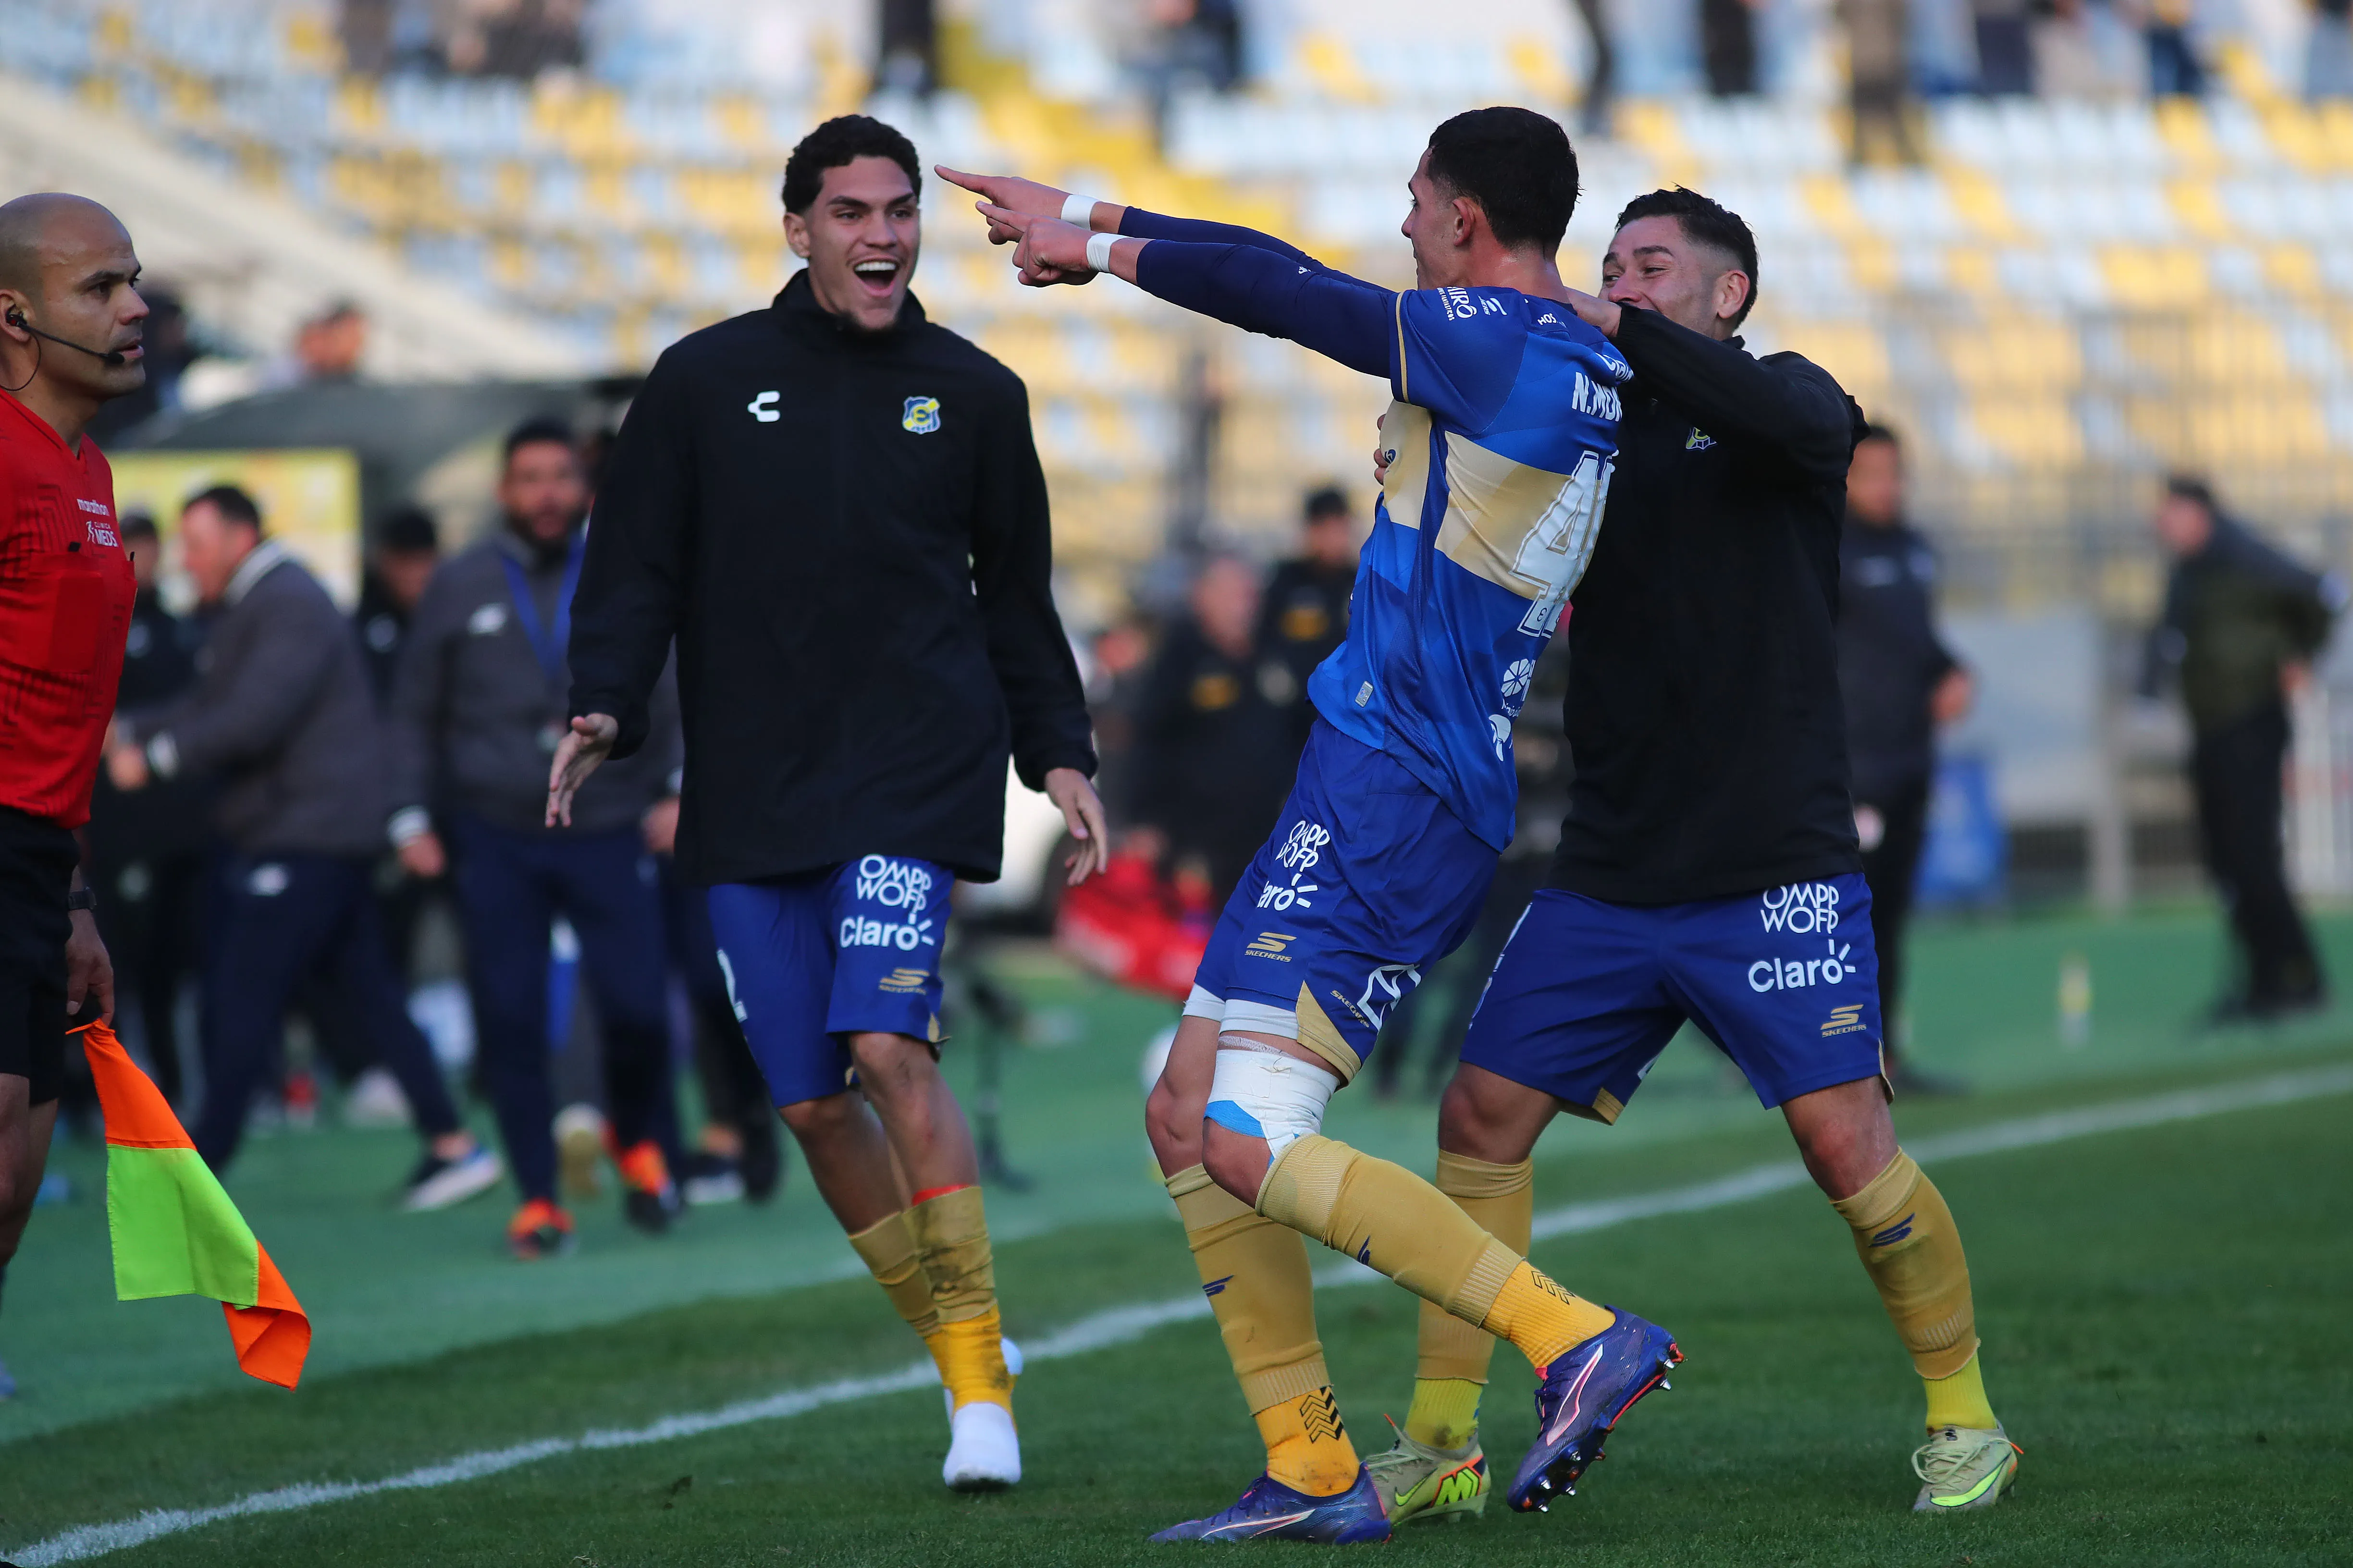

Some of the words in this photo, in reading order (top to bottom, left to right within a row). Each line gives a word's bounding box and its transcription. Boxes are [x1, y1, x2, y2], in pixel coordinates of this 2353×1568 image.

[841, 914, 920, 951] Claro
[1244, 950, 1293, 963] SKECHERS
[1748, 957, 1843, 992] Claro
[1821, 1024, 1867, 1038] SKECHERS
